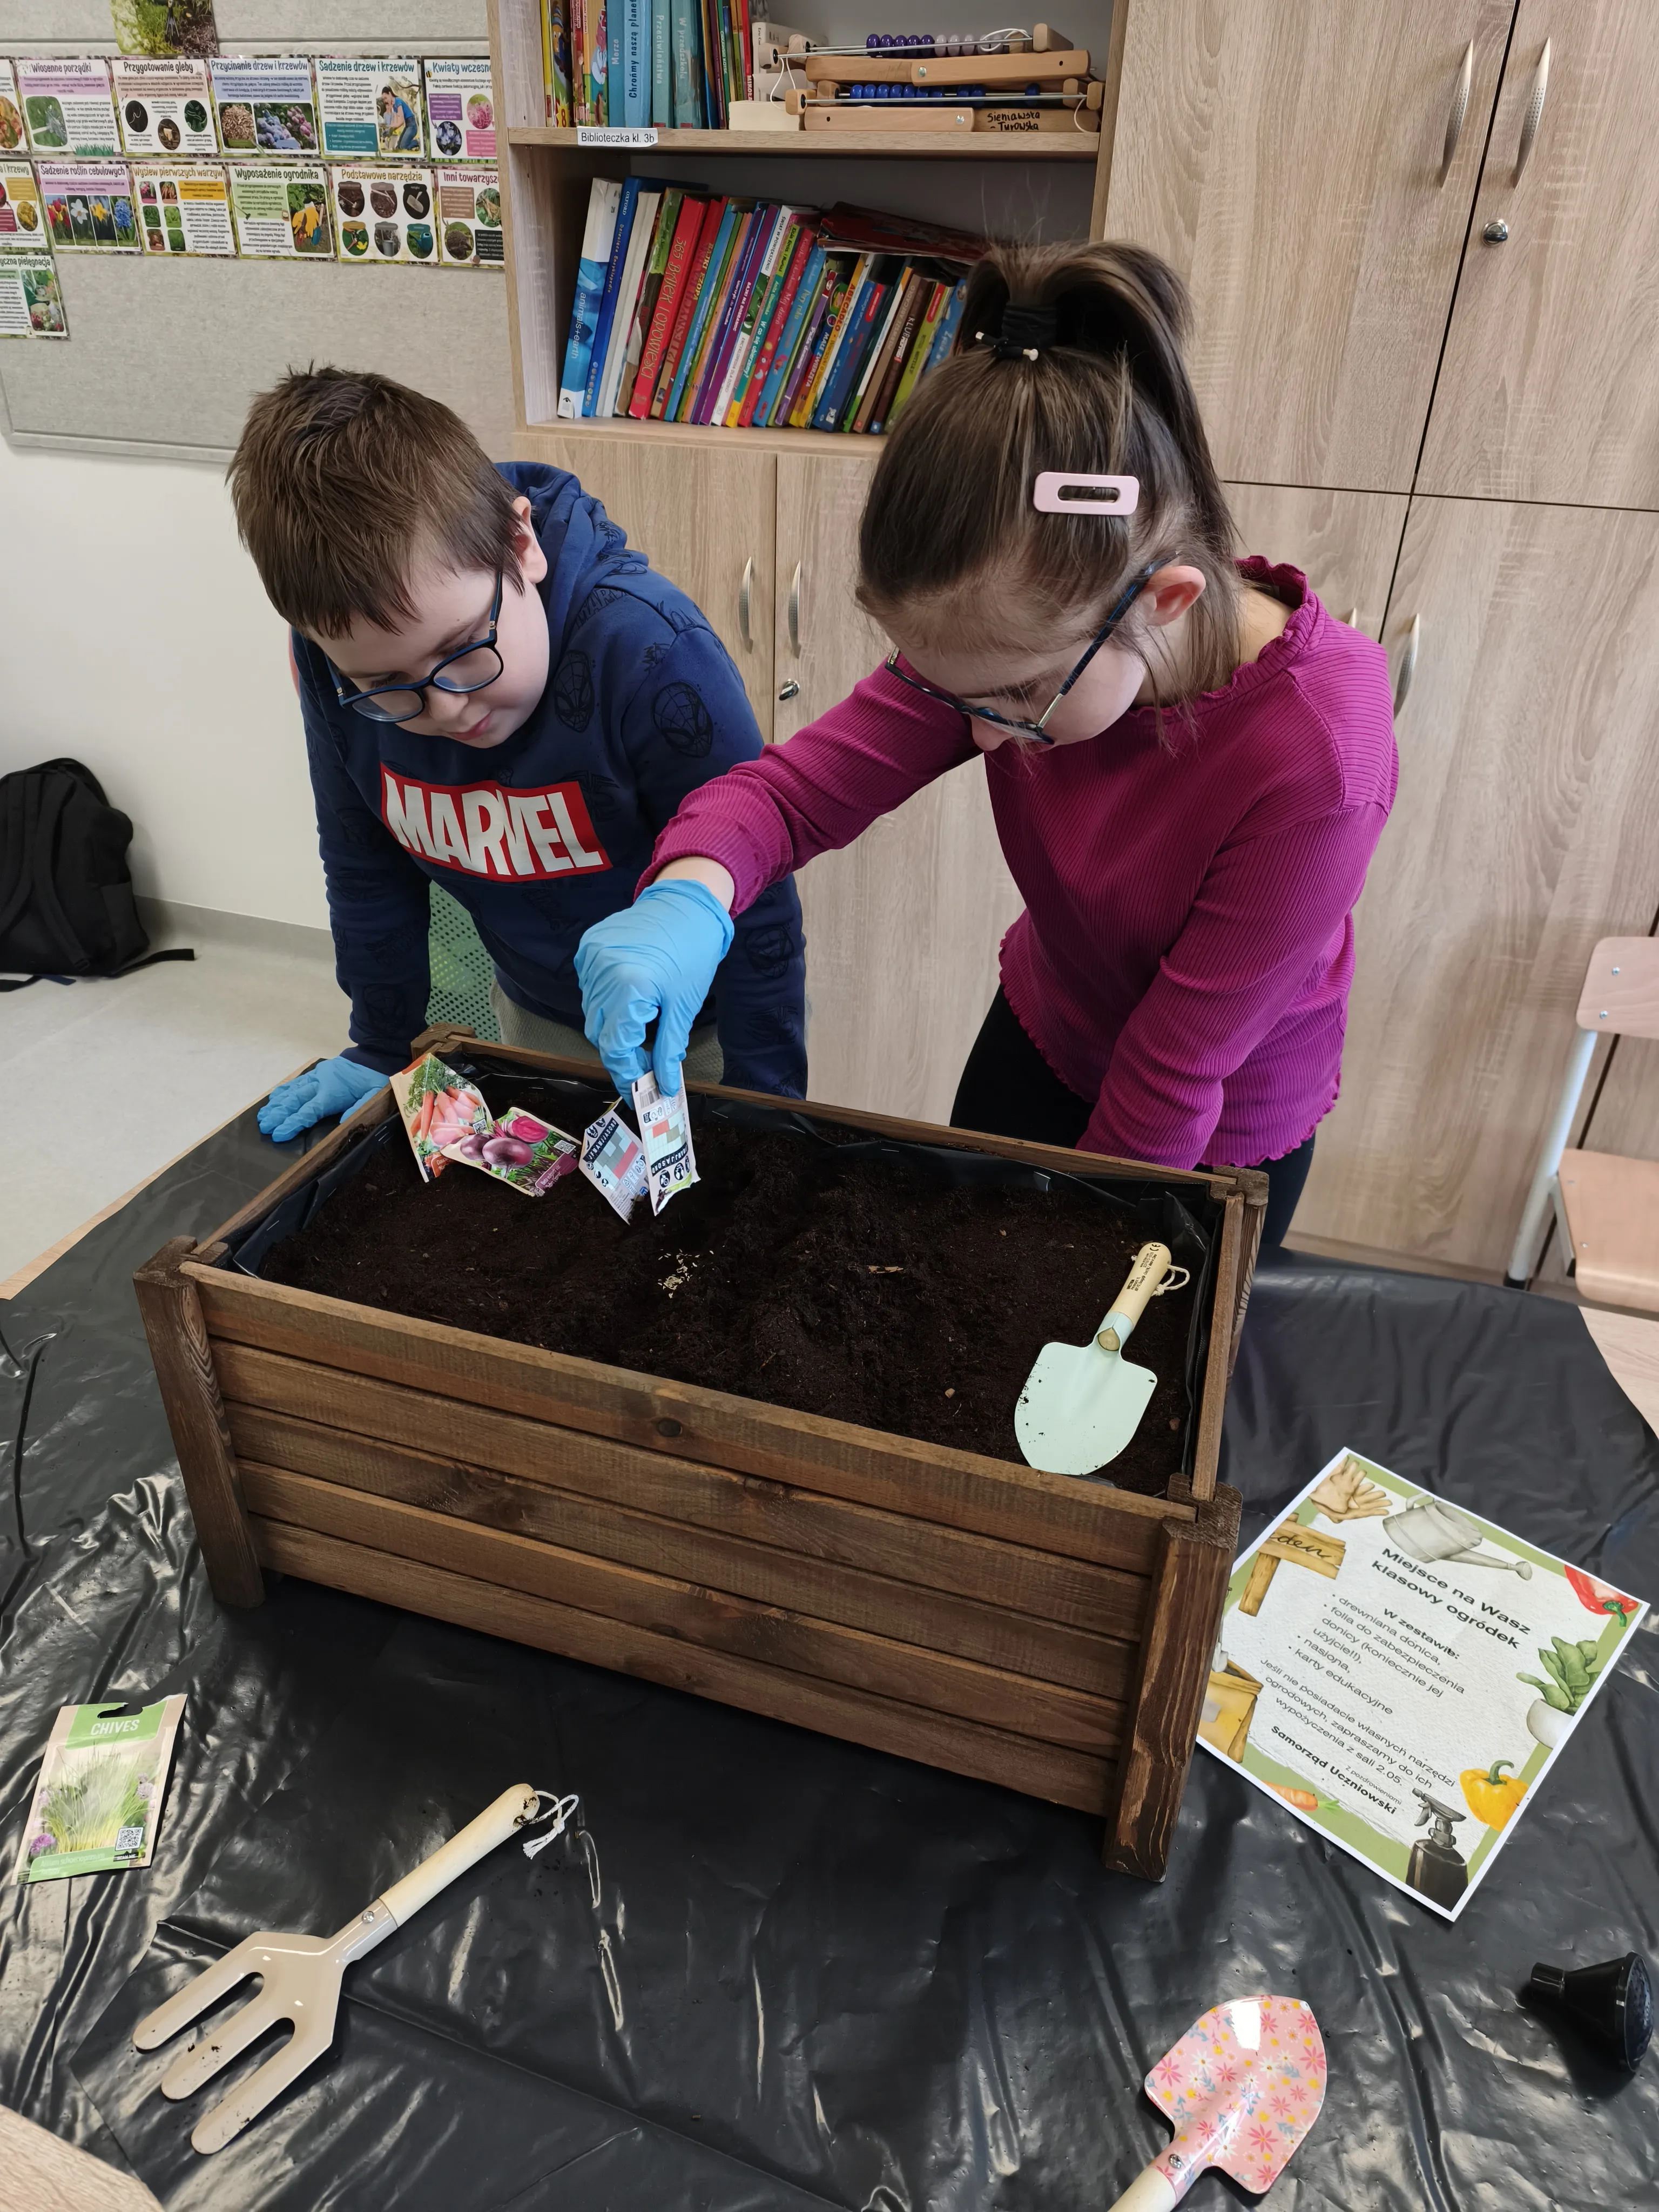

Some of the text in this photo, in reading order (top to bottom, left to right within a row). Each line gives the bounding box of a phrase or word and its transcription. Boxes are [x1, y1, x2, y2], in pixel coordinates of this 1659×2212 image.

[31, 62, 91, 75] Wiosenne porządki
[124, 61, 193, 74] Przygotowanie gleby
[211, 60, 308, 72] Przycinanie drzew i krzewów
[319, 60, 414, 72] Sadzenie drzew i krzewów
[433, 62, 460, 75] Kwiaty
[629, 60, 639, 98] Chrońmy
[987, 111, 1040, 123] Sieniawska
[582, 132, 655, 143] Biblioteczka kl. 3b
[3, 164, 6, 173] i
[6, 164, 29, 175] krzewy
[41, 164, 125, 177] Sadzenie roślin cebulowych
[133, 166, 223, 179] Wysiew pierwszych warzyw
[234, 168, 319, 181] Wyposażenie ogrodnika
[341, 169, 422, 182] Podstawowe narzędzia
[444, 172, 457, 181] Inni
[622, 191, 631, 215] OXFORD
[18, 257, 51, 268] pielęgnacja
[672, 238, 687, 260] 365
[764, 237, 780, 271] POWIĘKSZENIU
[659, 262, 680, 304] BAJEK
[692, 243, 714, 301] BAJKI EZOPA
[741, 296, 747, 305] NA
[743, 281, 752, 296] BAJKI
[792, 288, 811, 320] Pory roku
[833, 283, 858, 332] ABECADŁO
[570, 292, 586, 359] animals+earth
[753, 335, 761, 345] się
[901, 316, 916, 339] KLUB
[744, 346, 758, 377] ubierzemy?
[804, 332, 830, 388] MAŁE ZWIERZĘTA
[385, 772, 603, 875] MARVEL
[1372, 1560, 1521, 1649] klasowy ogródek
[1382, 1548, 1531, 1635] Miejsce na Wasz
[1313, 1628, 1362, 1664] użyjcie!!),
[1339, 1597, 1441, 1665] drewniana donica,
[1400, 1618, 1460, 1660] zestawie:
[1304, 1638, 1351, 1674] nasiona,
[1322, 1617, 1445, 1698] donicy (koniecznie jej
[1331, 1607, 1465, 1694] folia do zabezpieczenia
[1294, 1648, 1393, 1715] karty edukacyjne
[90, 1719, 140, 1737] CHIVES
[1260, 1659, 1456, 1788] Jeśli nie posiadacie własnych narzędzi
[1265, 1676, 1433, 1789] ogrodowych, zapraszamy do ich
[1276, 1697, 1346, 1748] wypożyczenia
[1355, 1750, 1375, 1767] sali
[1375, 1765, 1402, 1786] 2.05.
[1271, 1725, 1398, 1815] Samorząd Uczniowski
[1351, 1770, 1402, 1805] pozdrowieniami
